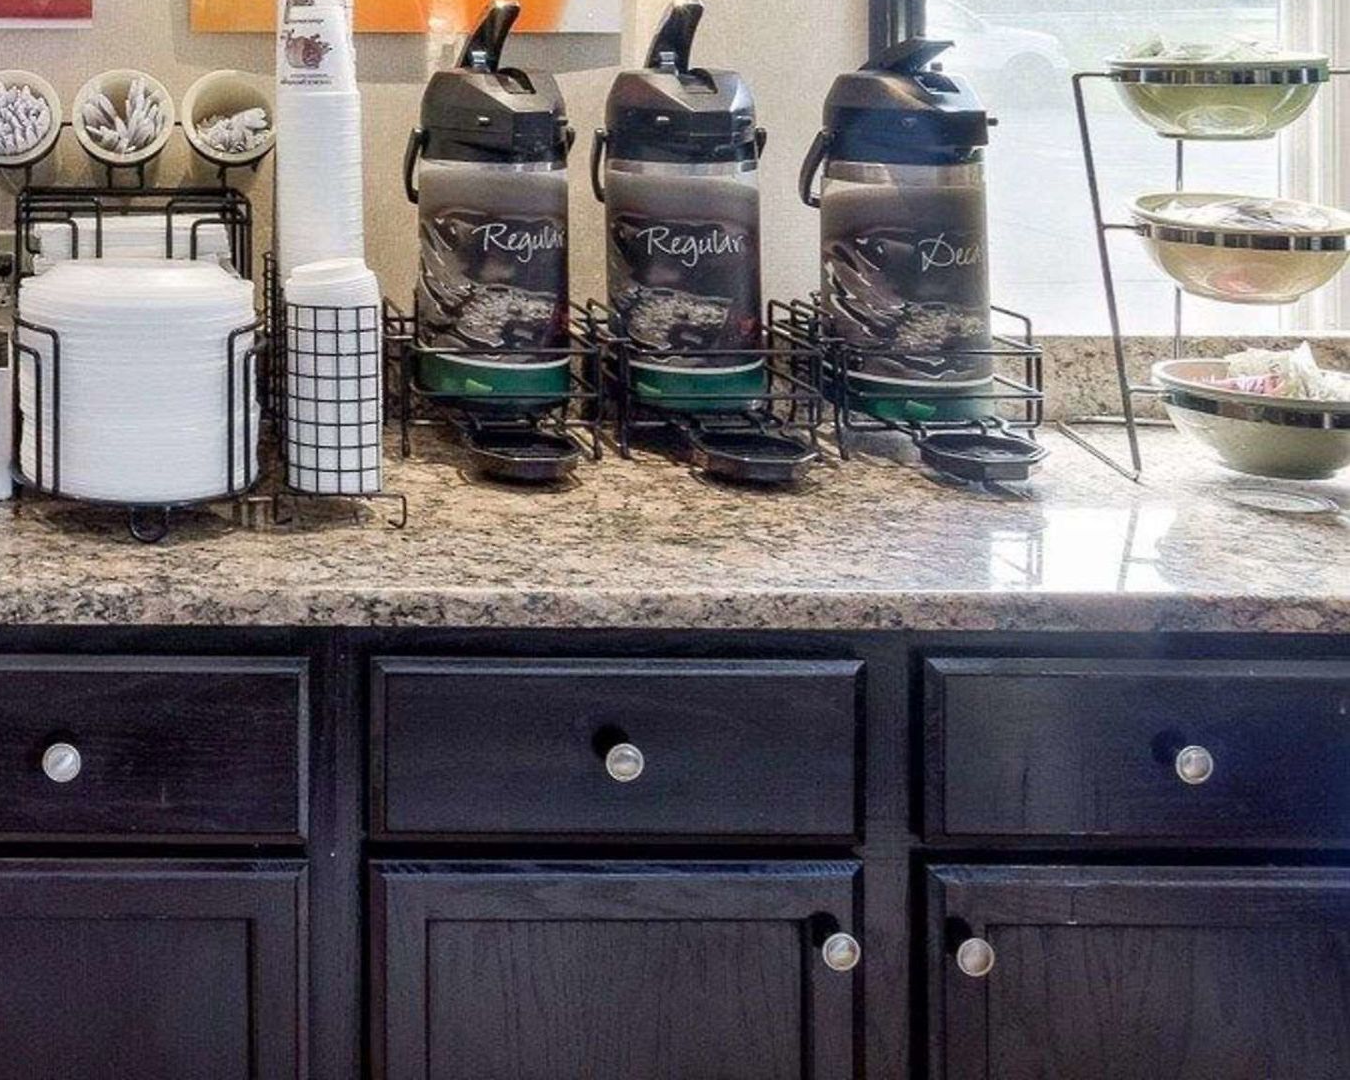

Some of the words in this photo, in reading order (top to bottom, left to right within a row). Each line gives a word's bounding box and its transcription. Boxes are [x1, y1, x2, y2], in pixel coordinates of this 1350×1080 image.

[471, 223, 565, 264] Regular
[635, 225, 744, 267] Regular
[917, 232, 984, 272] Deca
